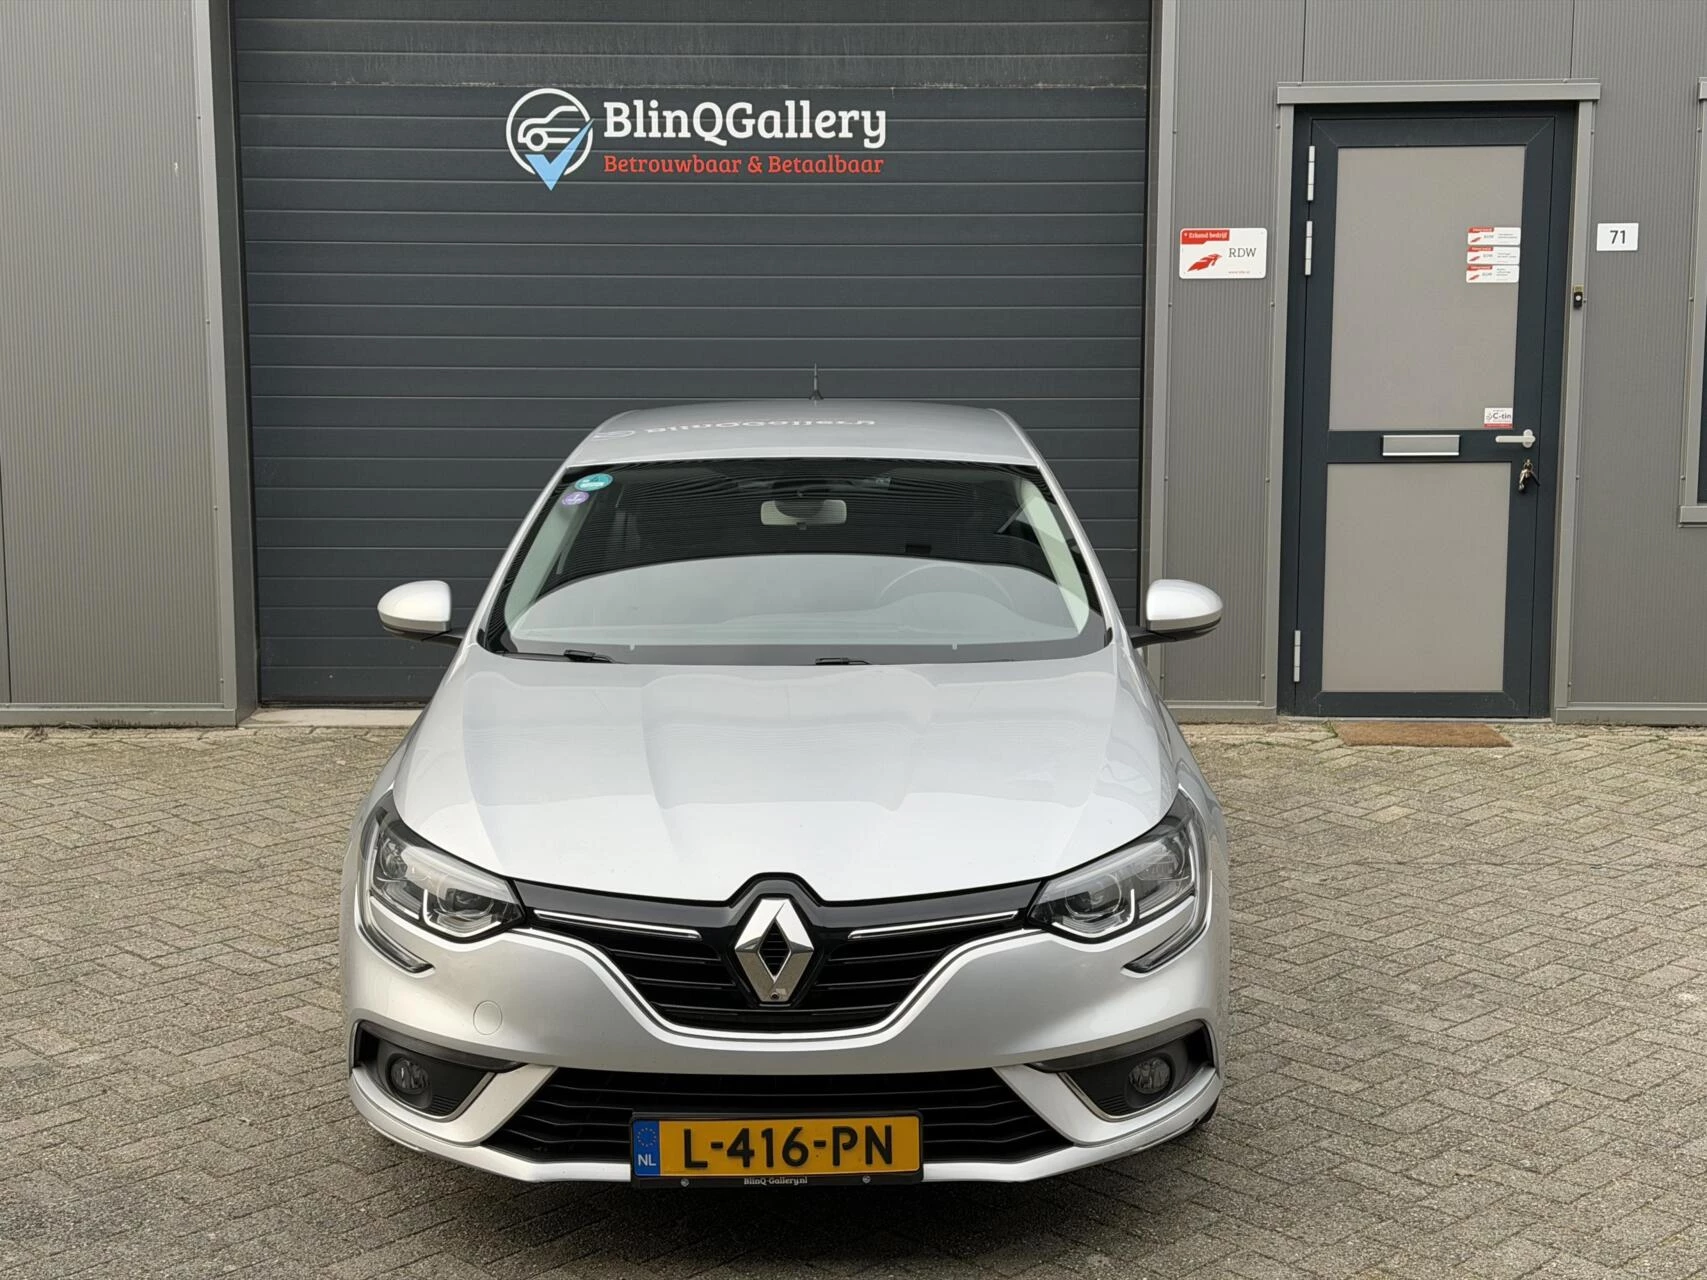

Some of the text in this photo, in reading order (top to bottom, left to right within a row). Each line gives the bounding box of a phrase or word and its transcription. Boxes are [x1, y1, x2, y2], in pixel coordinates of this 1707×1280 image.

[603, 99, 887, 150] BlinQGallery
[603, 155, 885, 174] Betrouwbaar & Betaalbaar
[1609, 229, 1626, 245] 71
[1228, 247, 1257, 258] RDW
[683, 1125, 893, 1169] L-416-PN
[637, 1153, 657, 1167] NL
